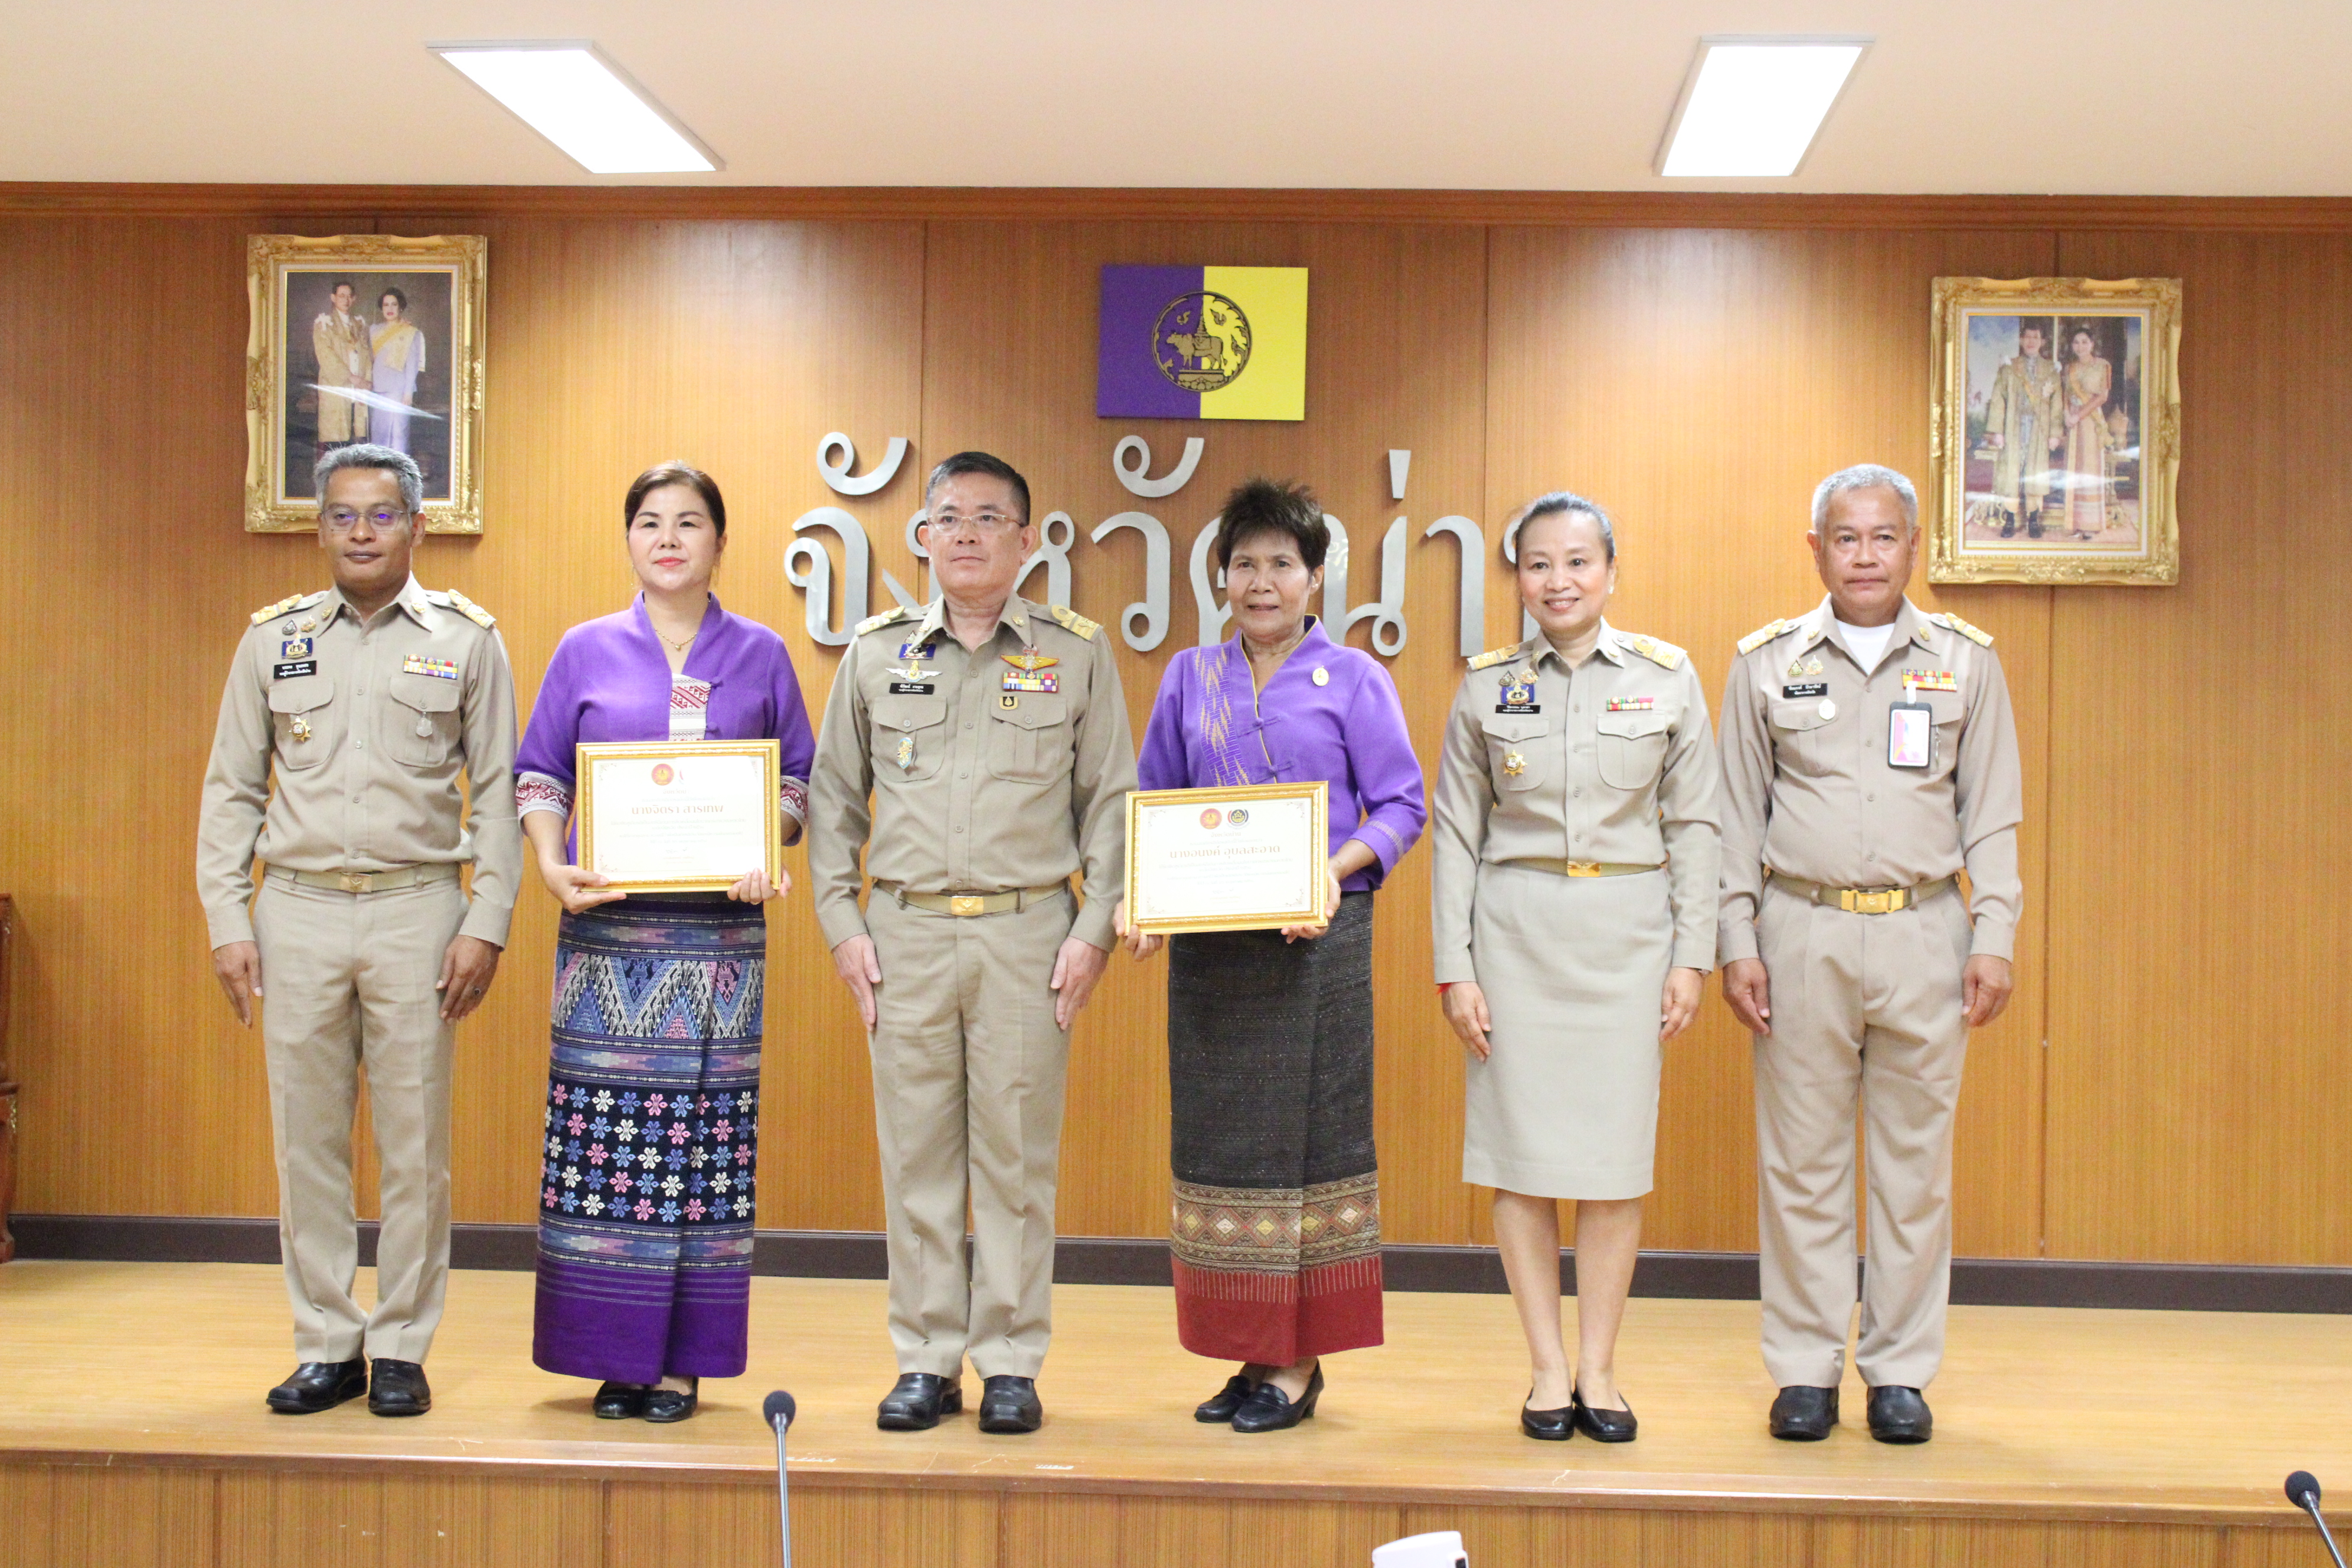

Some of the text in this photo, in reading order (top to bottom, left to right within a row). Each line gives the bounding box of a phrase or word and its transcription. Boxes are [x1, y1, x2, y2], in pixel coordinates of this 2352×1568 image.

[683, 805, 724, 814] สารเทพ
[1170, 845, 1280, 859] นางอนงค์ อุบลสะอาด
